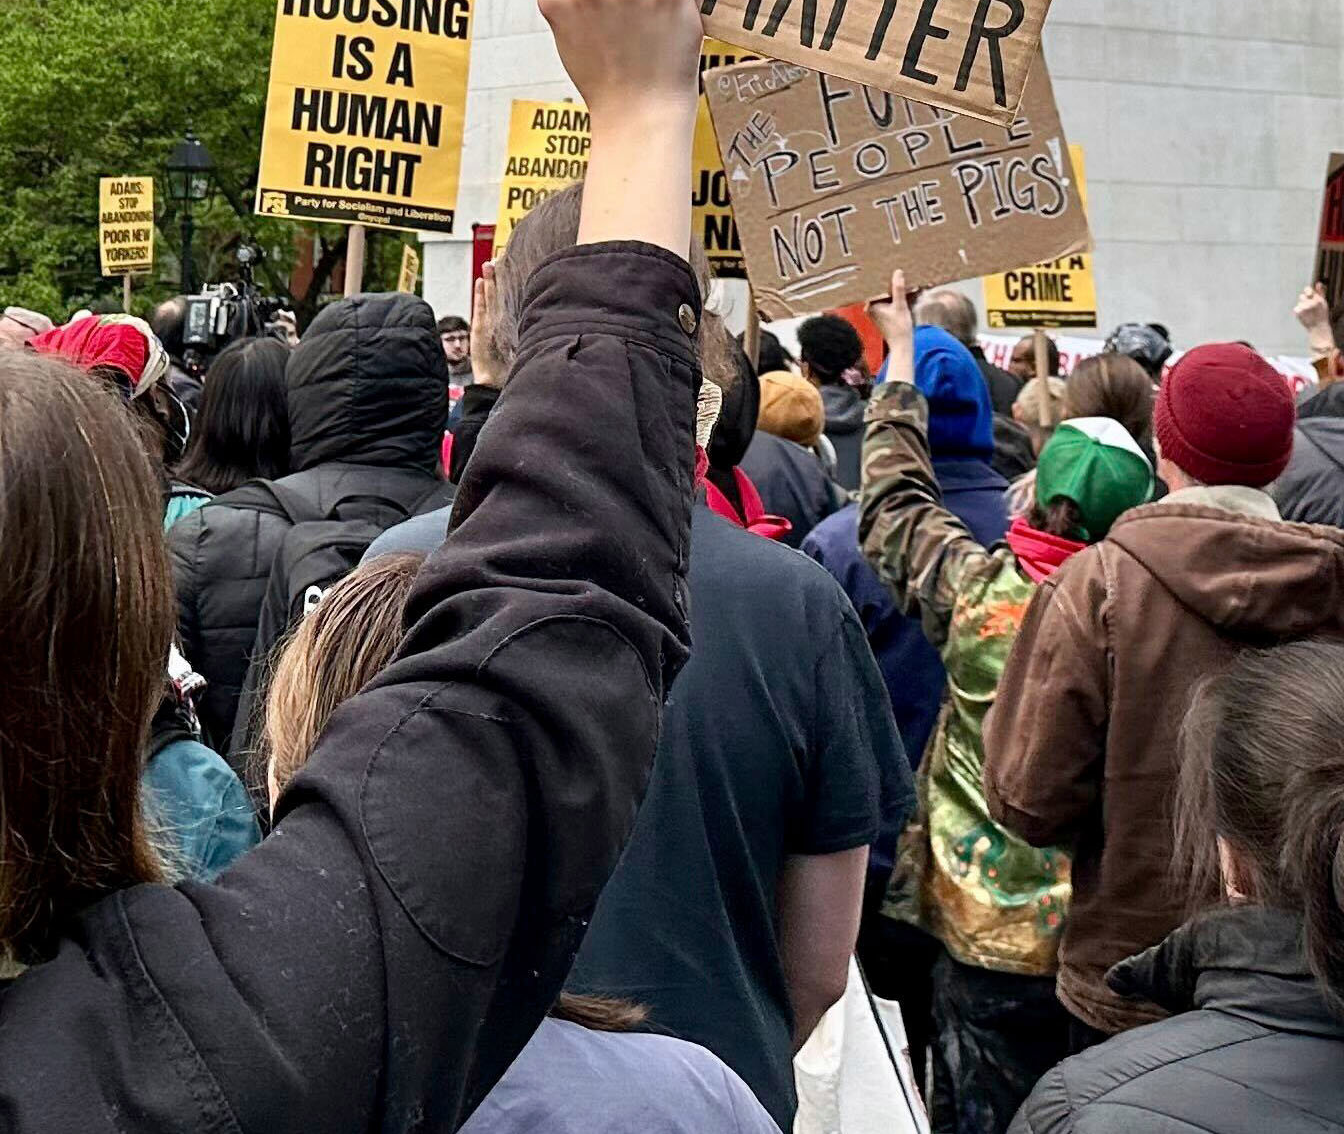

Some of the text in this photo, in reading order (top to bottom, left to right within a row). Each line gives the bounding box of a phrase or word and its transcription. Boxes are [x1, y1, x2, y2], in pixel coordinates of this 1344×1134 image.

[331, 34, 415, 89] IS A
[291, 87, 443, 148] HUMAN
[531, 109, 591, 132] ADAM
[545, 135, 591, 156] STOP
[727, 110, 777, 169] THE
[304, 141, 422, 198] RIGHT
[505, 157, 588, 179] ABANDO
[757, 116, 1035, 207] PEOPLE
[294, 195, 320, 208] Party
[322, 197, 337, 209] for
[386, 206, 403, 216] and
[405, 207, 451, 222] Liberation
[771, 204, 858, 280] NOT
[874, 180, 947, 244] THE
[954, 137, 1070, 228] PIGS!
[104, 229, 130, 244] POOR
[1004, 272, 1073, 302] CRIME
